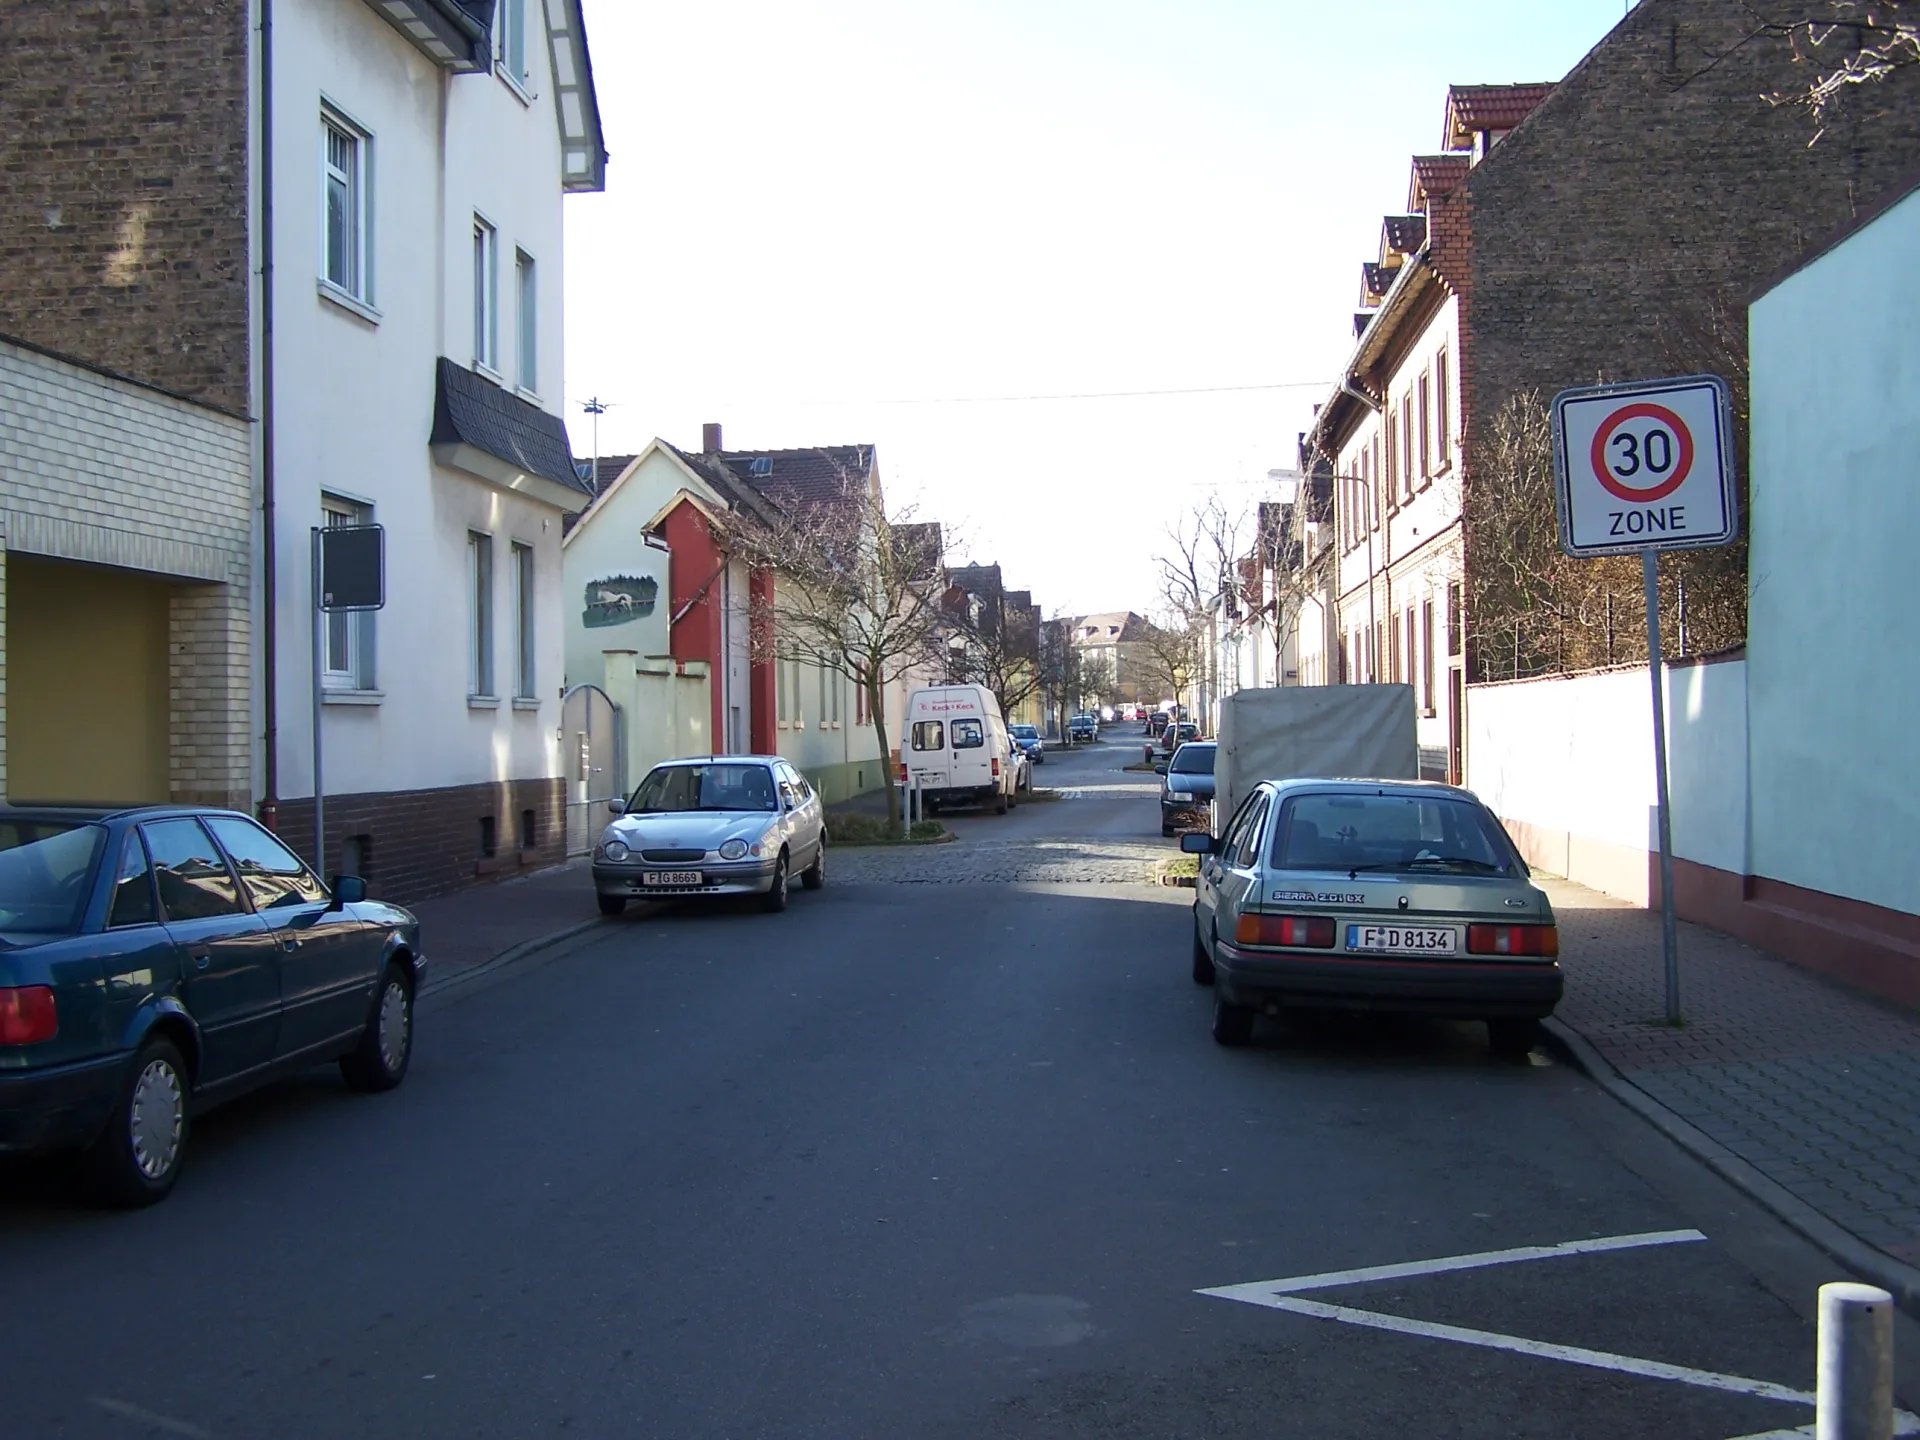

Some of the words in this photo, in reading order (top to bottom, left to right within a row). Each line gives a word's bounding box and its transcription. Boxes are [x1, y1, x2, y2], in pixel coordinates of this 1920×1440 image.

[1612, 429, 1671, 477] 30
[1608, 506, 1686, 535] ZONE
[956, 702, 974, 710] Keck
[672, 872, 697, 883] 8669
[1273, 891, 1315, 901] SIERRA
[1346, 894, 1364, 903] LX
[1364, 929, 1377, 946] F
[1388, 930, 1400, 947] D
[1404, 931, 1448, 949] 8134
